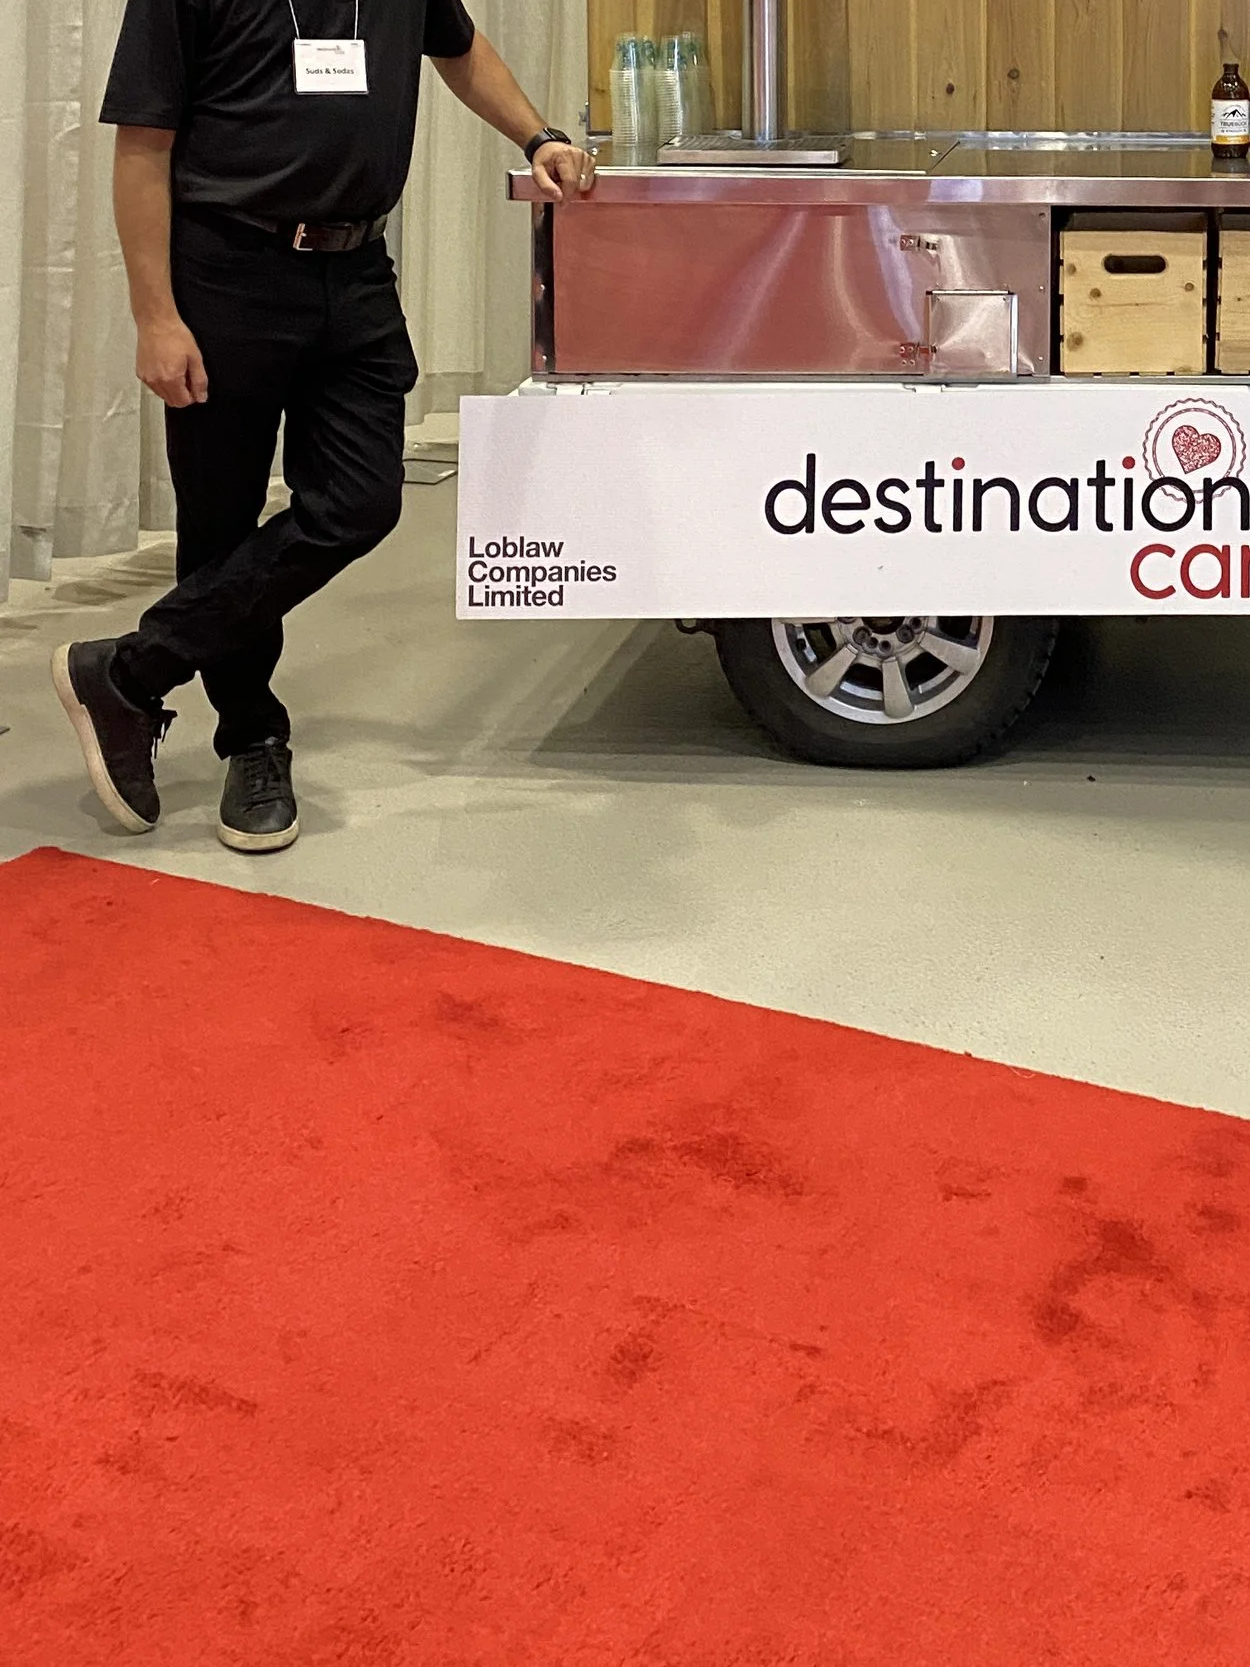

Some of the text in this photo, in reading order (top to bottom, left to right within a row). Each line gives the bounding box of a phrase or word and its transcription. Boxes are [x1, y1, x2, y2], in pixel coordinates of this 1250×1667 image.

[306, 67, 355, 75] Suds & Sodas
[468, 535, 565, 558] Loblaw
[468, 560, 617, 587] Companies
[468, 584, 565, 607] Limited
